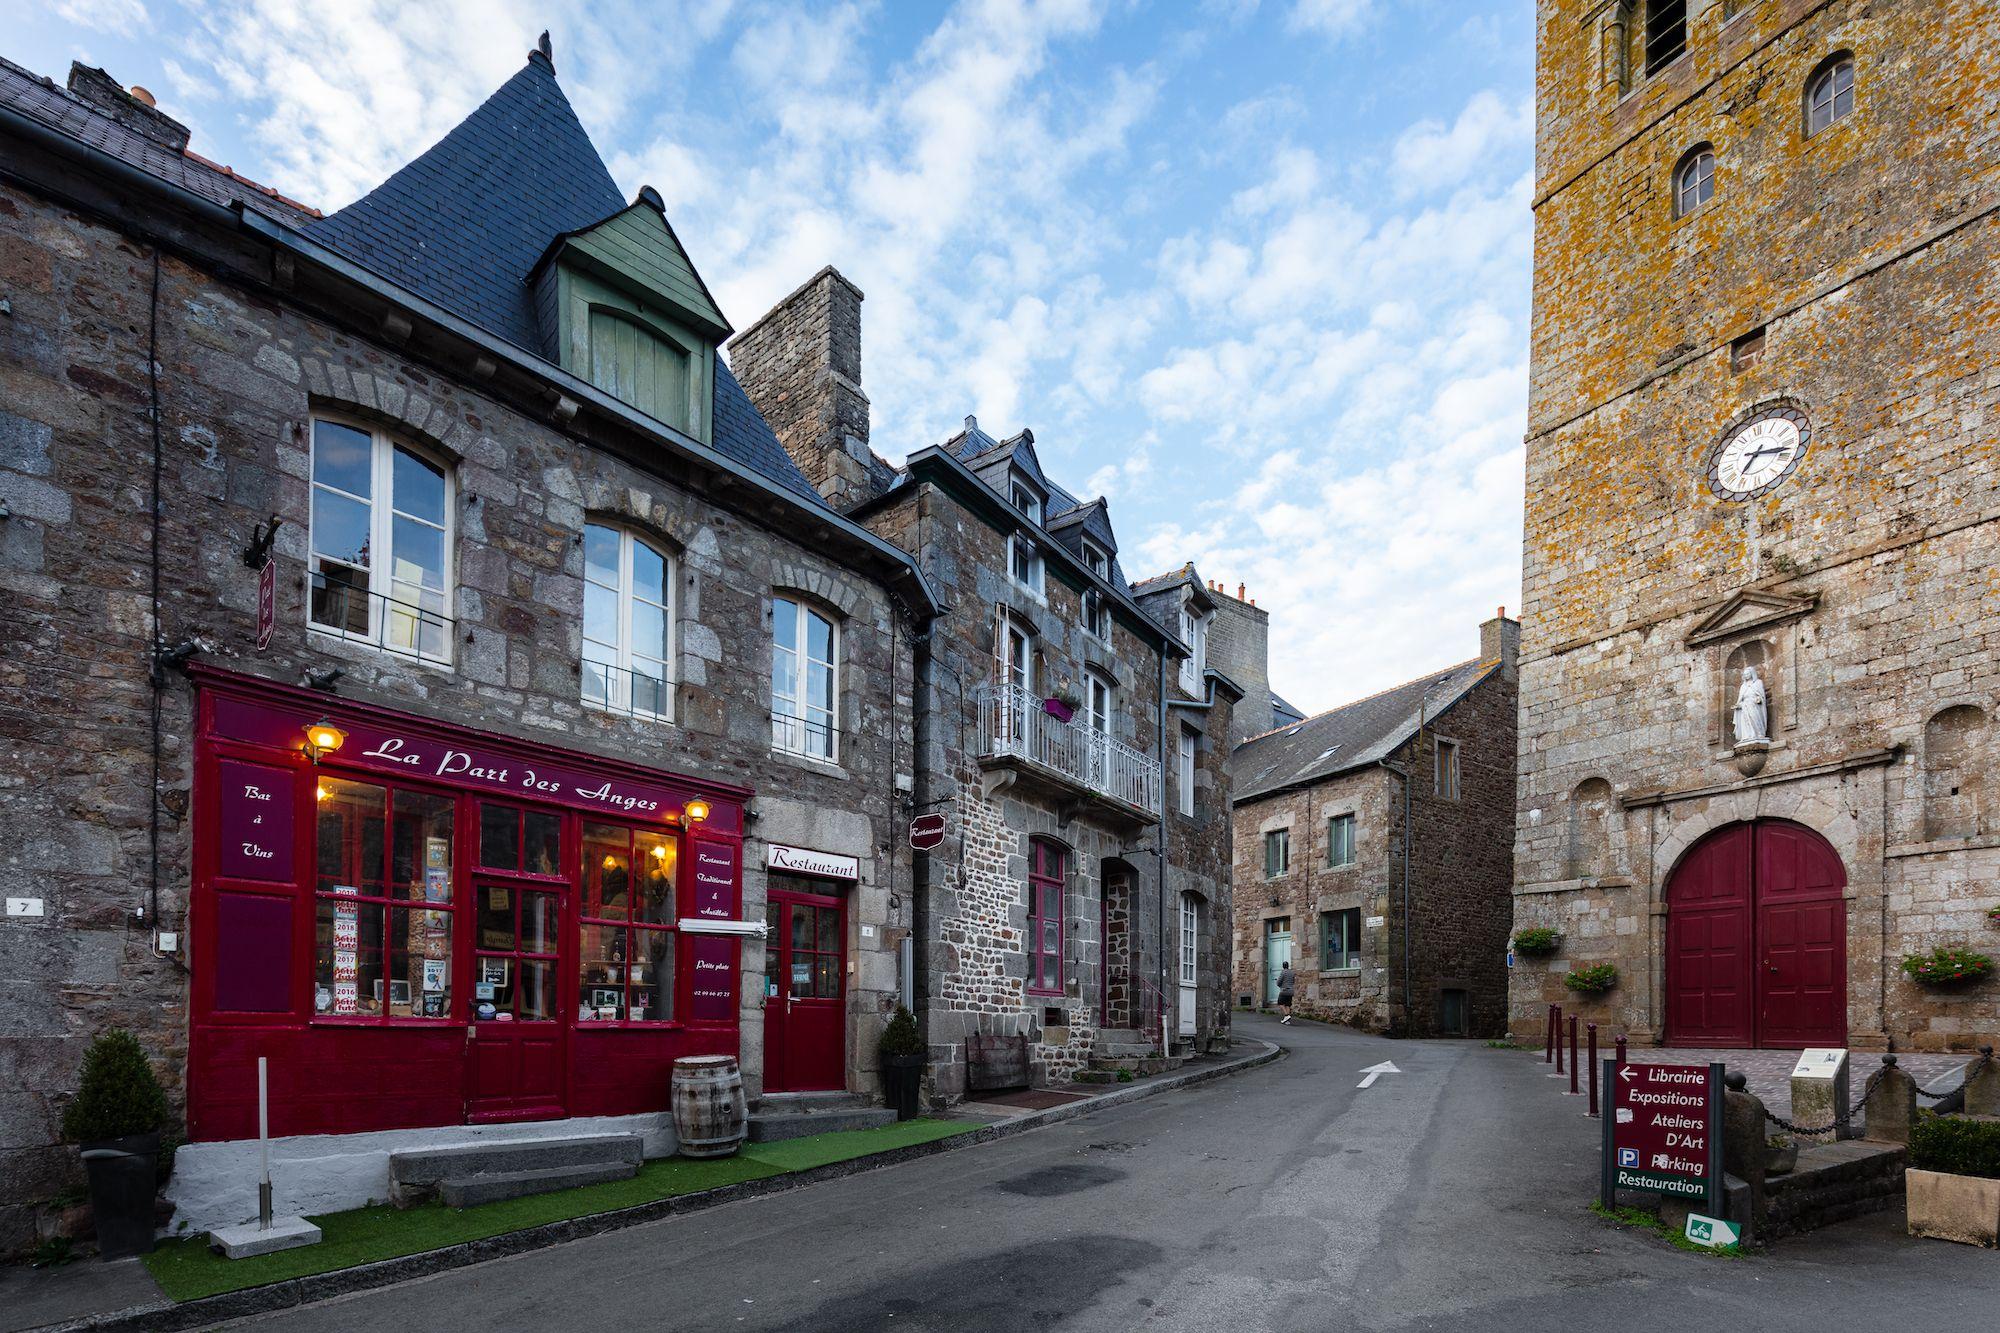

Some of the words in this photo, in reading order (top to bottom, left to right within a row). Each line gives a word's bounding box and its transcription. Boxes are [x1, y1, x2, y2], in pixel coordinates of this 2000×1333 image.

[362, 738, 421, 765] La
[435, 750, 508, 783] Part
[522, 769, 561, 792] des
[574, 782, 658, 811] Anges
[245, 785, 272, 801] Bar
[253, 814, 262, 824] à
[911, 827, 944, 837] Restaurant
[242, 842, 274, 859] Vins
[699, 853, 731, 866] Restaurant
[773, 847, 854, 877] Restaurant
[697, 872, 733, 886] Traditionnel
[712, 892, 718, 900] &
[20, 902, 30, 912] 7
[1648, 1068, 1705, 1084] Librairie
[1628, 1088, 1705, 1106] Expositions
[1651, 1112, 1704, 1130] Ateliers
[1618, 1171, 1704, 1195] Restauration
